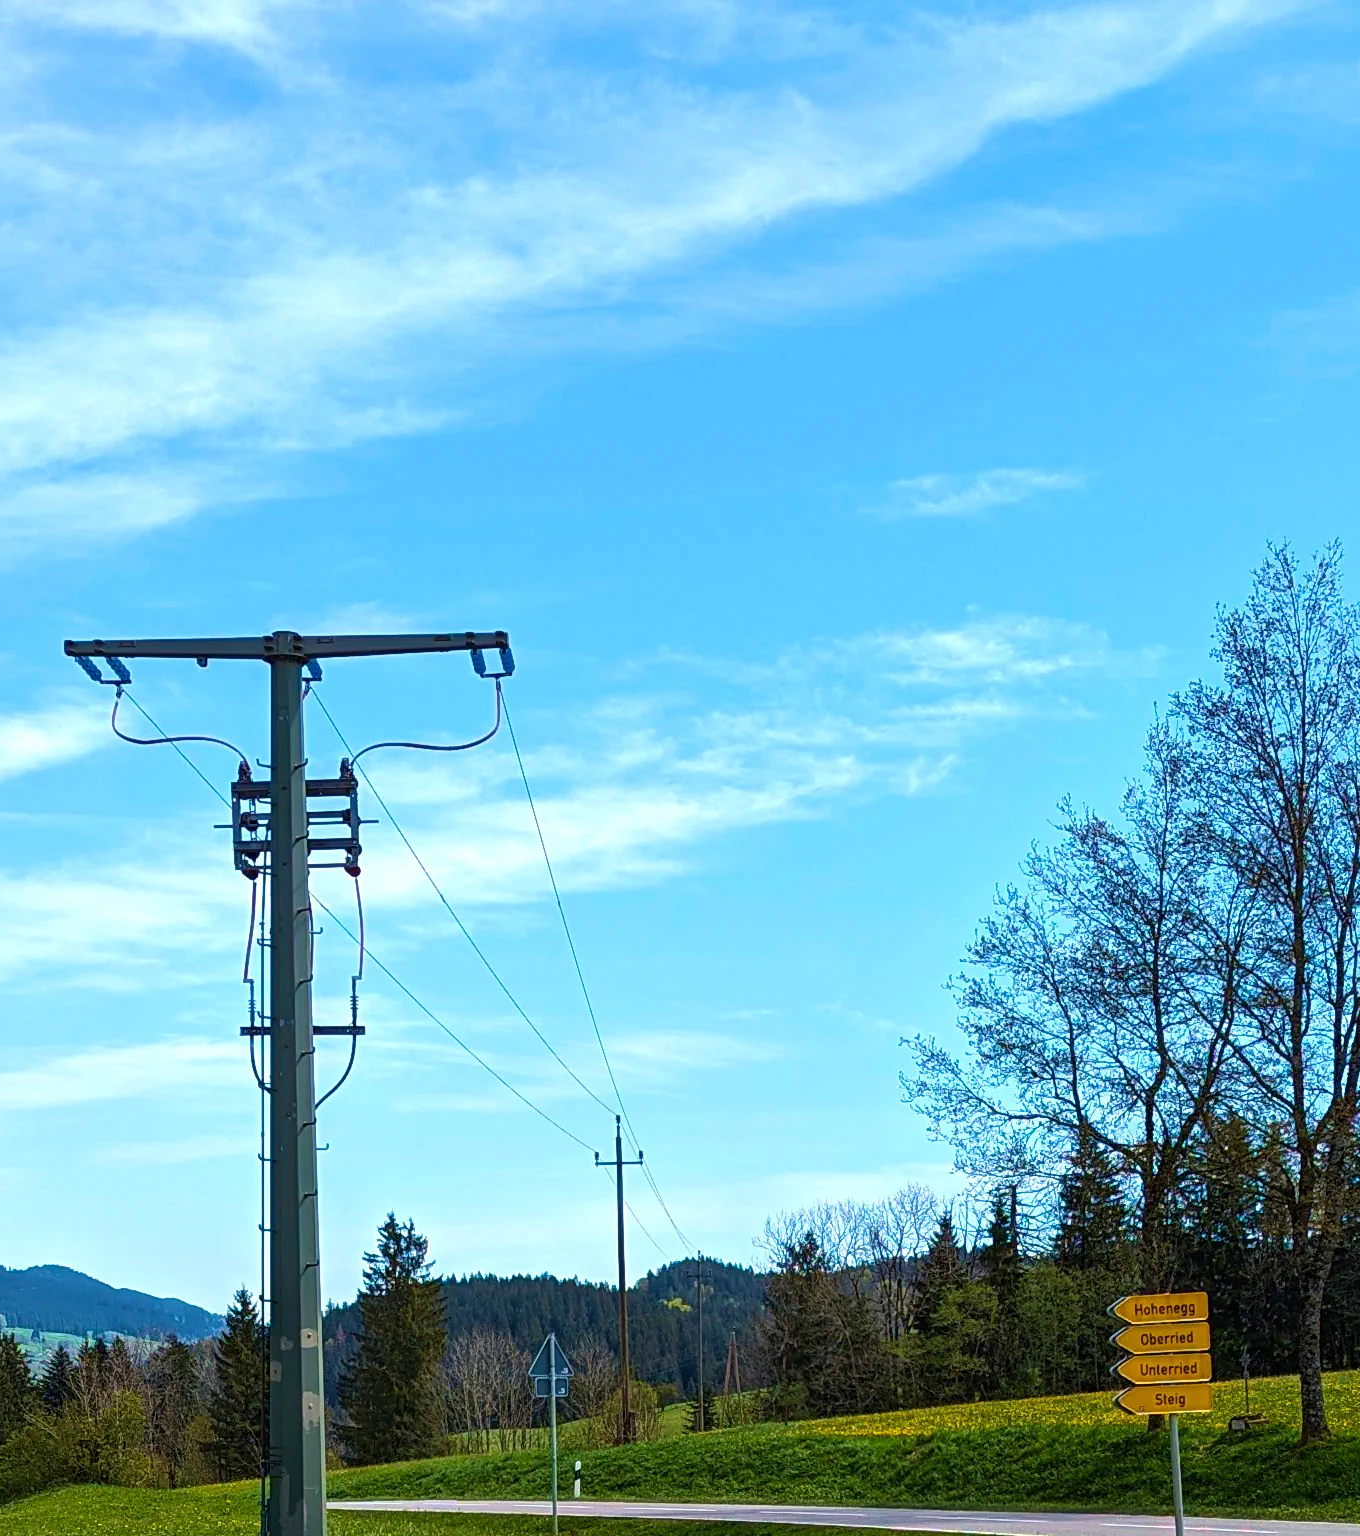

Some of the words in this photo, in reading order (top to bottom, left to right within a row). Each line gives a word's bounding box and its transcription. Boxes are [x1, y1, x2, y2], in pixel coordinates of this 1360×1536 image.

[1134, 1303, 1196, 1316] Hohenegg
[1140, 1331, 1194, 1346] Oberried
[1140, 1362, 1198, 1376] Unterried
[1155, 1393, 1186, 1407] Steig
